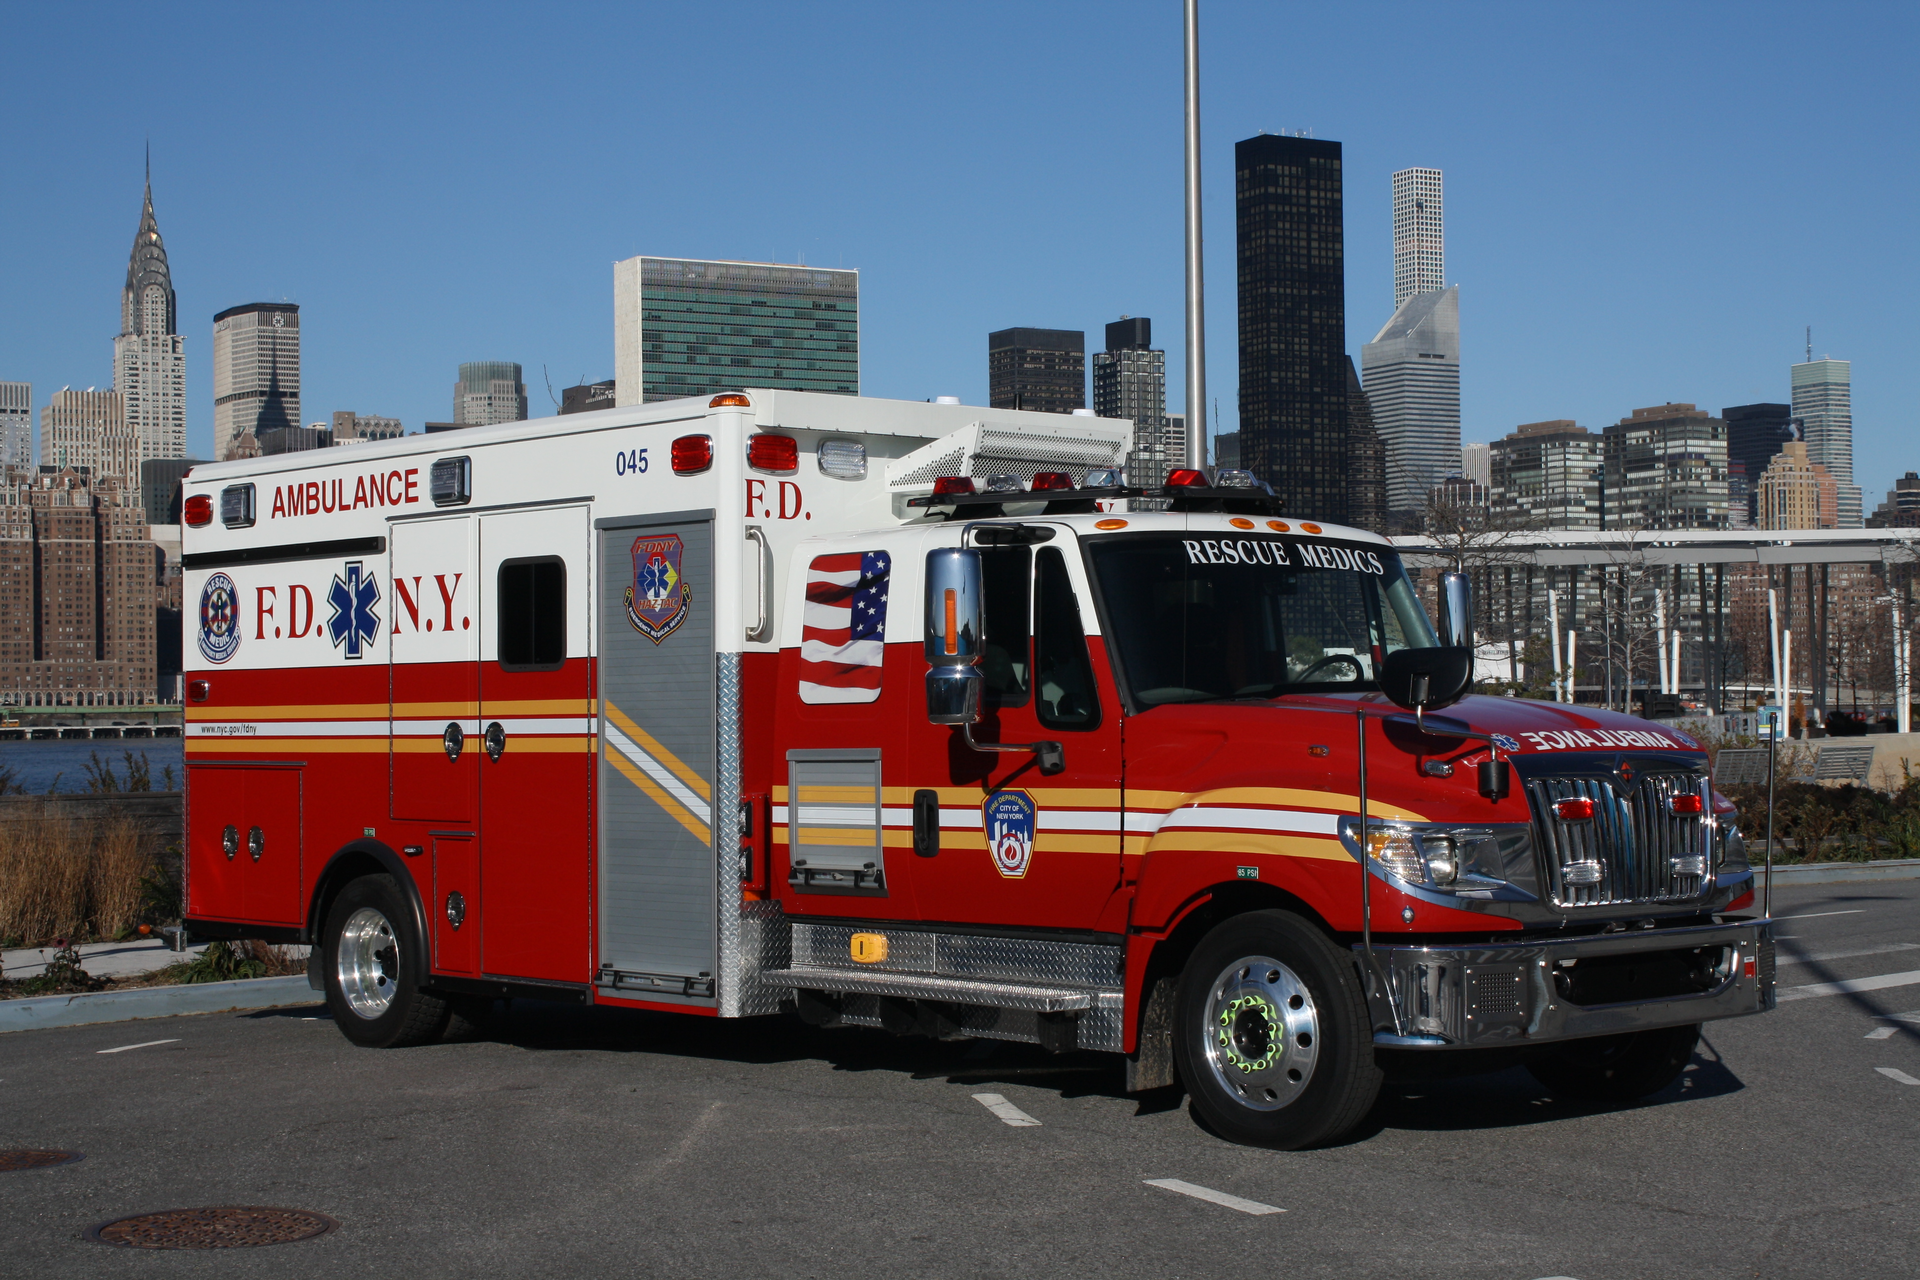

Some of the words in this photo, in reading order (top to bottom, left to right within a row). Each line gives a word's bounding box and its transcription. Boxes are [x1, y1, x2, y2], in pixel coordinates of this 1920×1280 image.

[616, 448, 649, 476] 045
[271, 468, 419, 519] AMBULANCE
[744, 478, 812, 521] F.D.
[635, 541, 676, 554] FDNY
[1182, 539, 1290, 566] RESCUE
[1296, 543, 1384, 576] MEDICS
[206, 577, 233, 596] RESCUE
[255, 584, 323, 640] F.D.
[391, 572, 470, 635] N.Y.
[638, 598, 678, 610] HAZ-TAC
[208, 631, 231, 648] MEDIC
[201, 722, 257, 736] www.nyc.gov/fdny
[988, 799, 1000, 815] FIRE
[998, 794, 1032, 815] DEPARTMENT
